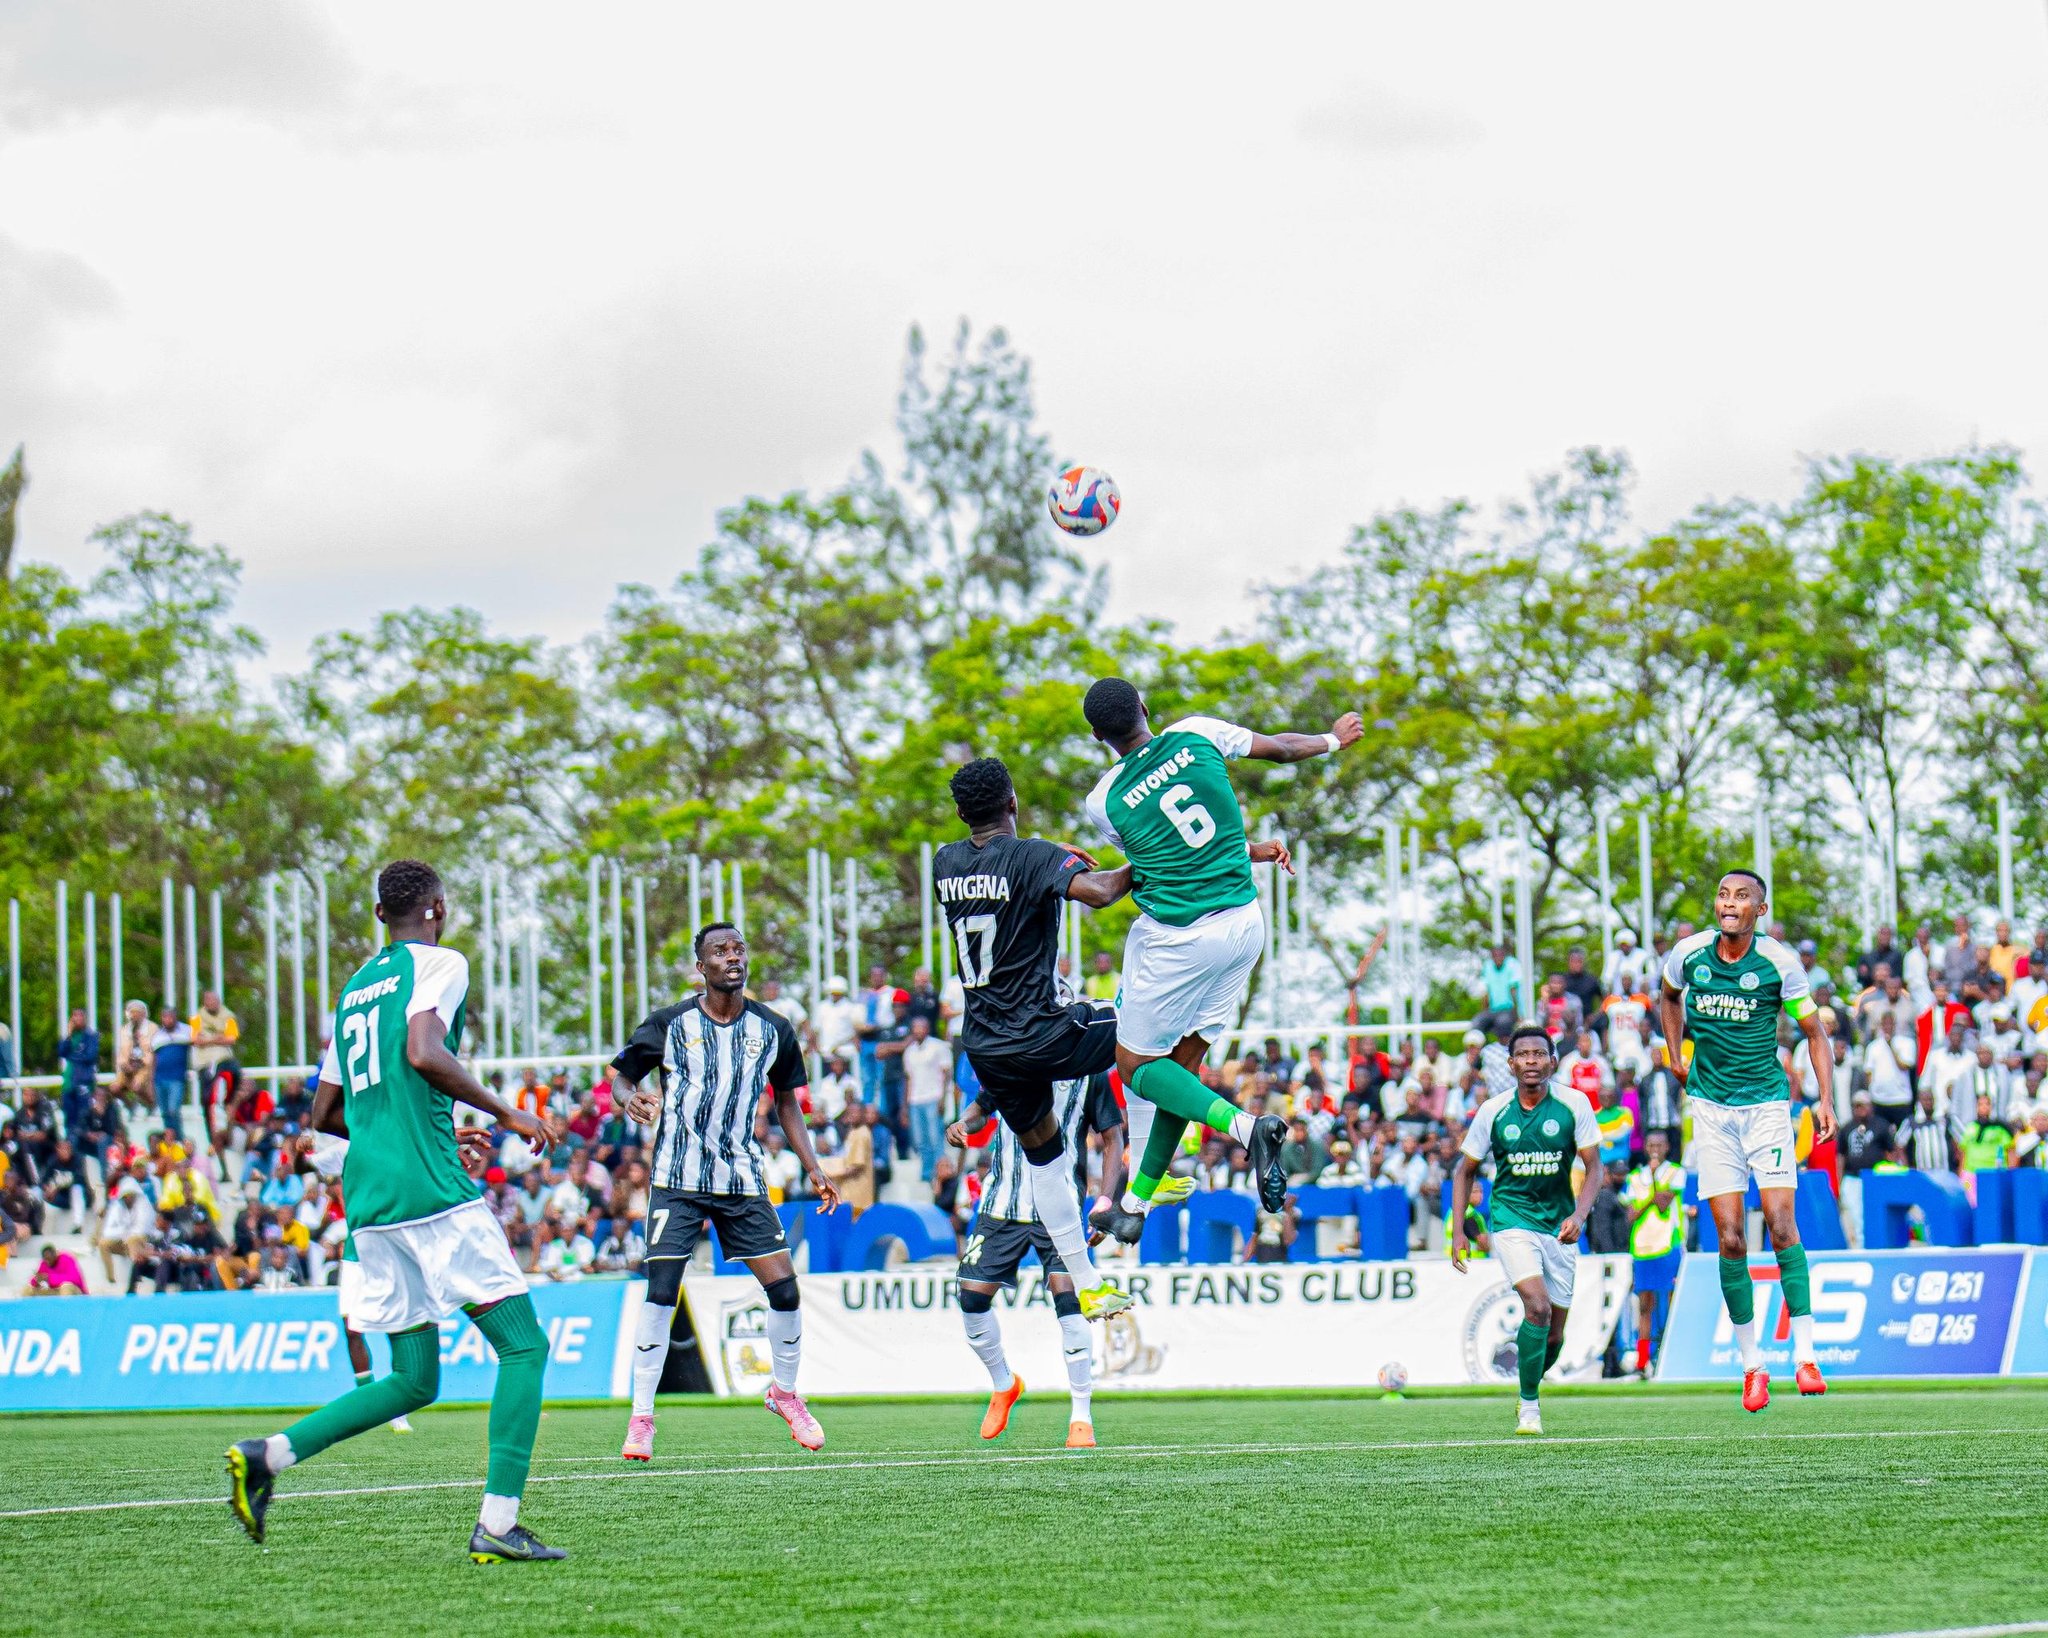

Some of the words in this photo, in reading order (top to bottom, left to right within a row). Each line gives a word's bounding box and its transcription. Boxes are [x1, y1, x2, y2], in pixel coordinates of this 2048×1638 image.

[1122, 759, 1179, 809] KIYOVU
[1174, 747, 1196, 769] SC
[1159, 784, 1216, 848] 6
[954, 914, 996, 988] 17
[342, 1004, 381, 1097] 21
[1770, 1147, 1783, 1168] 7
[651, 1208, 670, 1246] 7
[1170, 1271, 1283, 1305] FANS
[1301, 1267, 1417, 1303] CLUB
[1946, 1271, 1985, 1302] 251
[119, 1321, 338, 1374] PREMIER
[1937, 1313, 1978, 1345] 265
